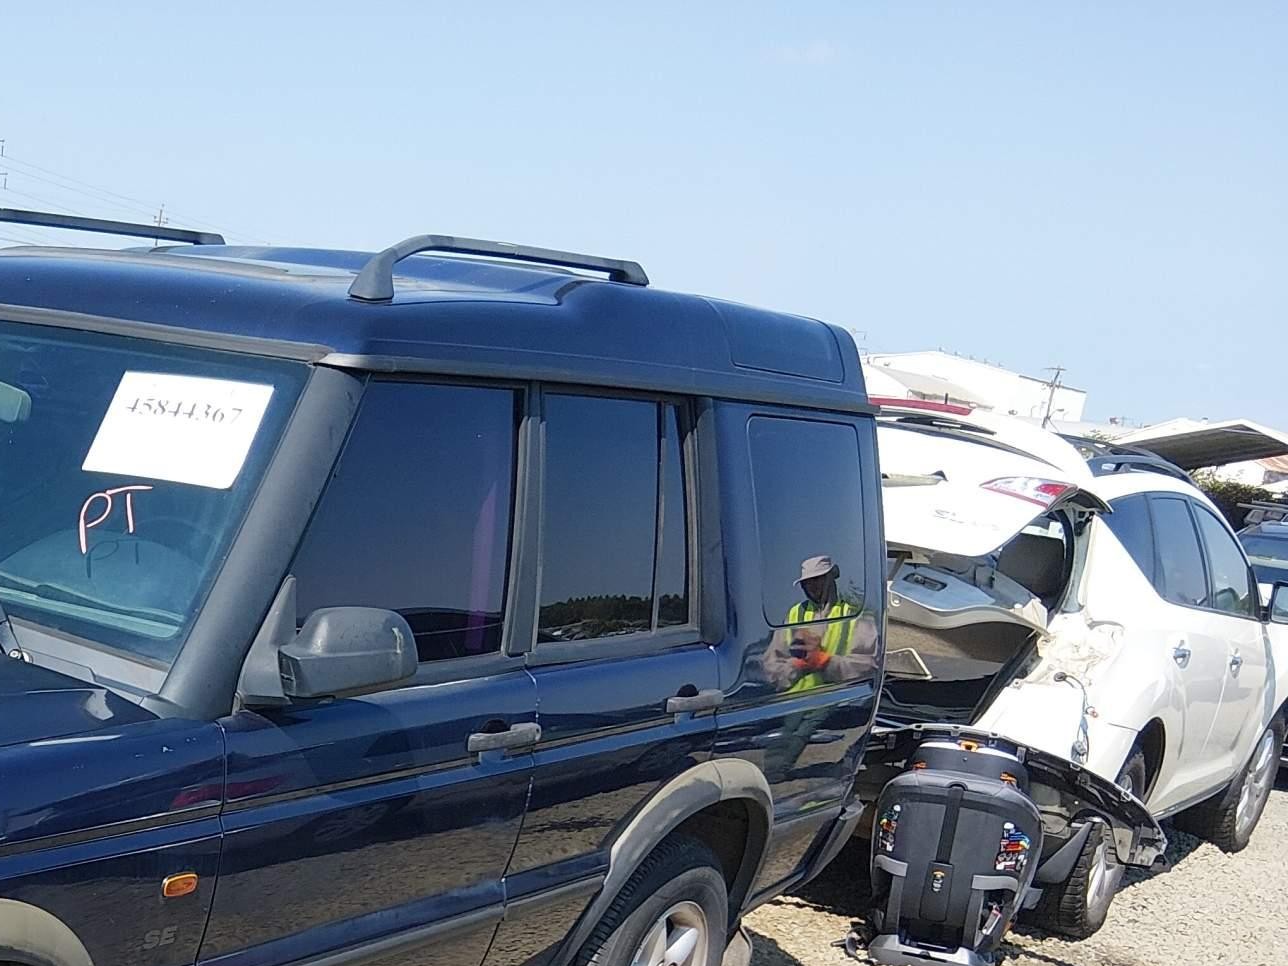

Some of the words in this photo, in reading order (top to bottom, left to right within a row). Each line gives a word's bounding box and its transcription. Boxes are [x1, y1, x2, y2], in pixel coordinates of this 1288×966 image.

[125, 397, 243, 425] 45844367
[78, 485, 154, 555] PT
[142, 926, 178, 949] SE
